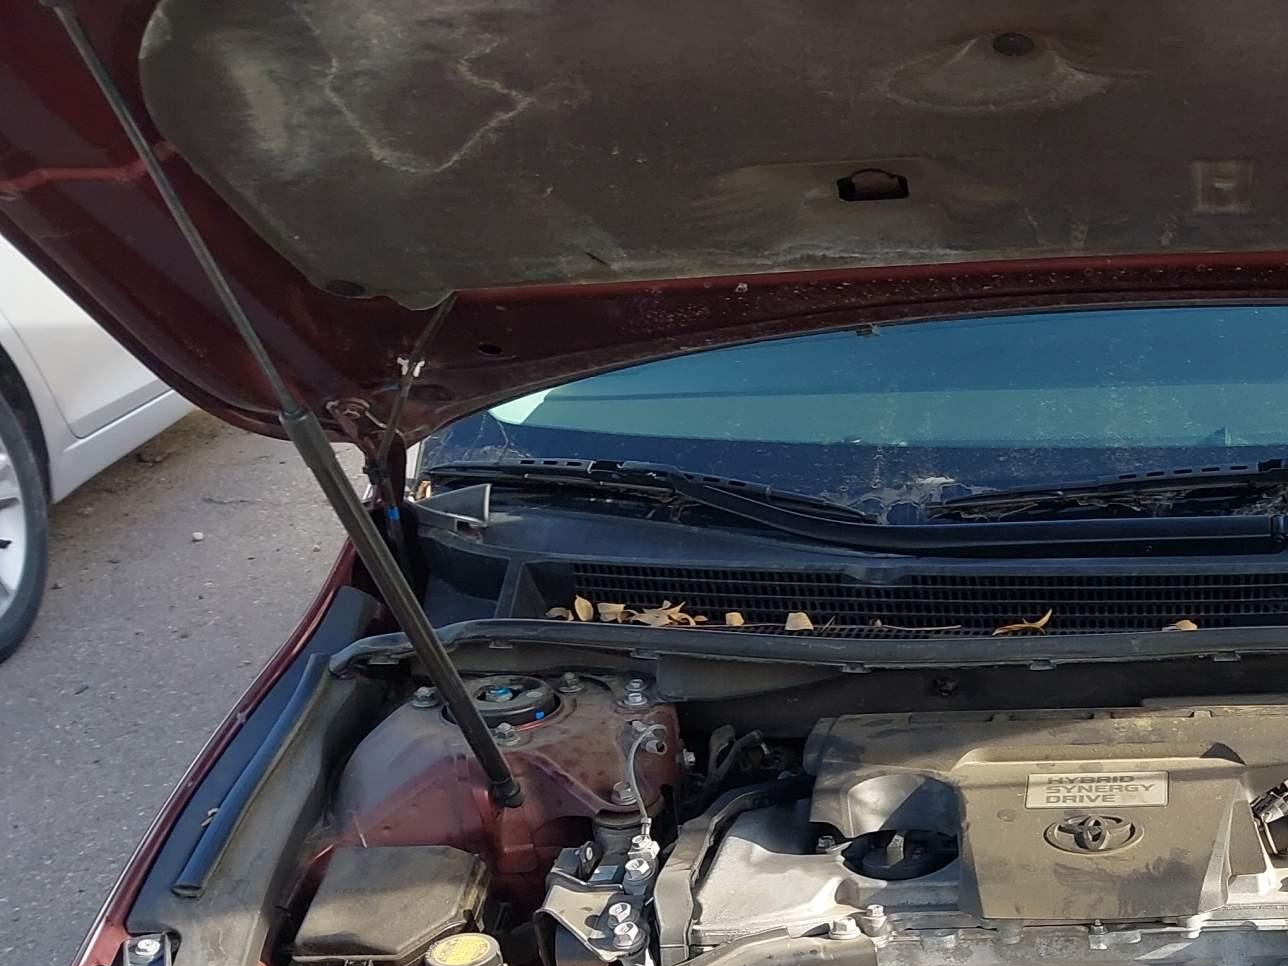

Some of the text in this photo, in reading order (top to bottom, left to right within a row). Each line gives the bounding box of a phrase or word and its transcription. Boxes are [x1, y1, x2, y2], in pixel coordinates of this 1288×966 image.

[1047, 775, 1135, 784] HYBRID
[1046, 784, 1155, 794] SYNERGY
[1046, 795, 1116, 804] DRIVE
